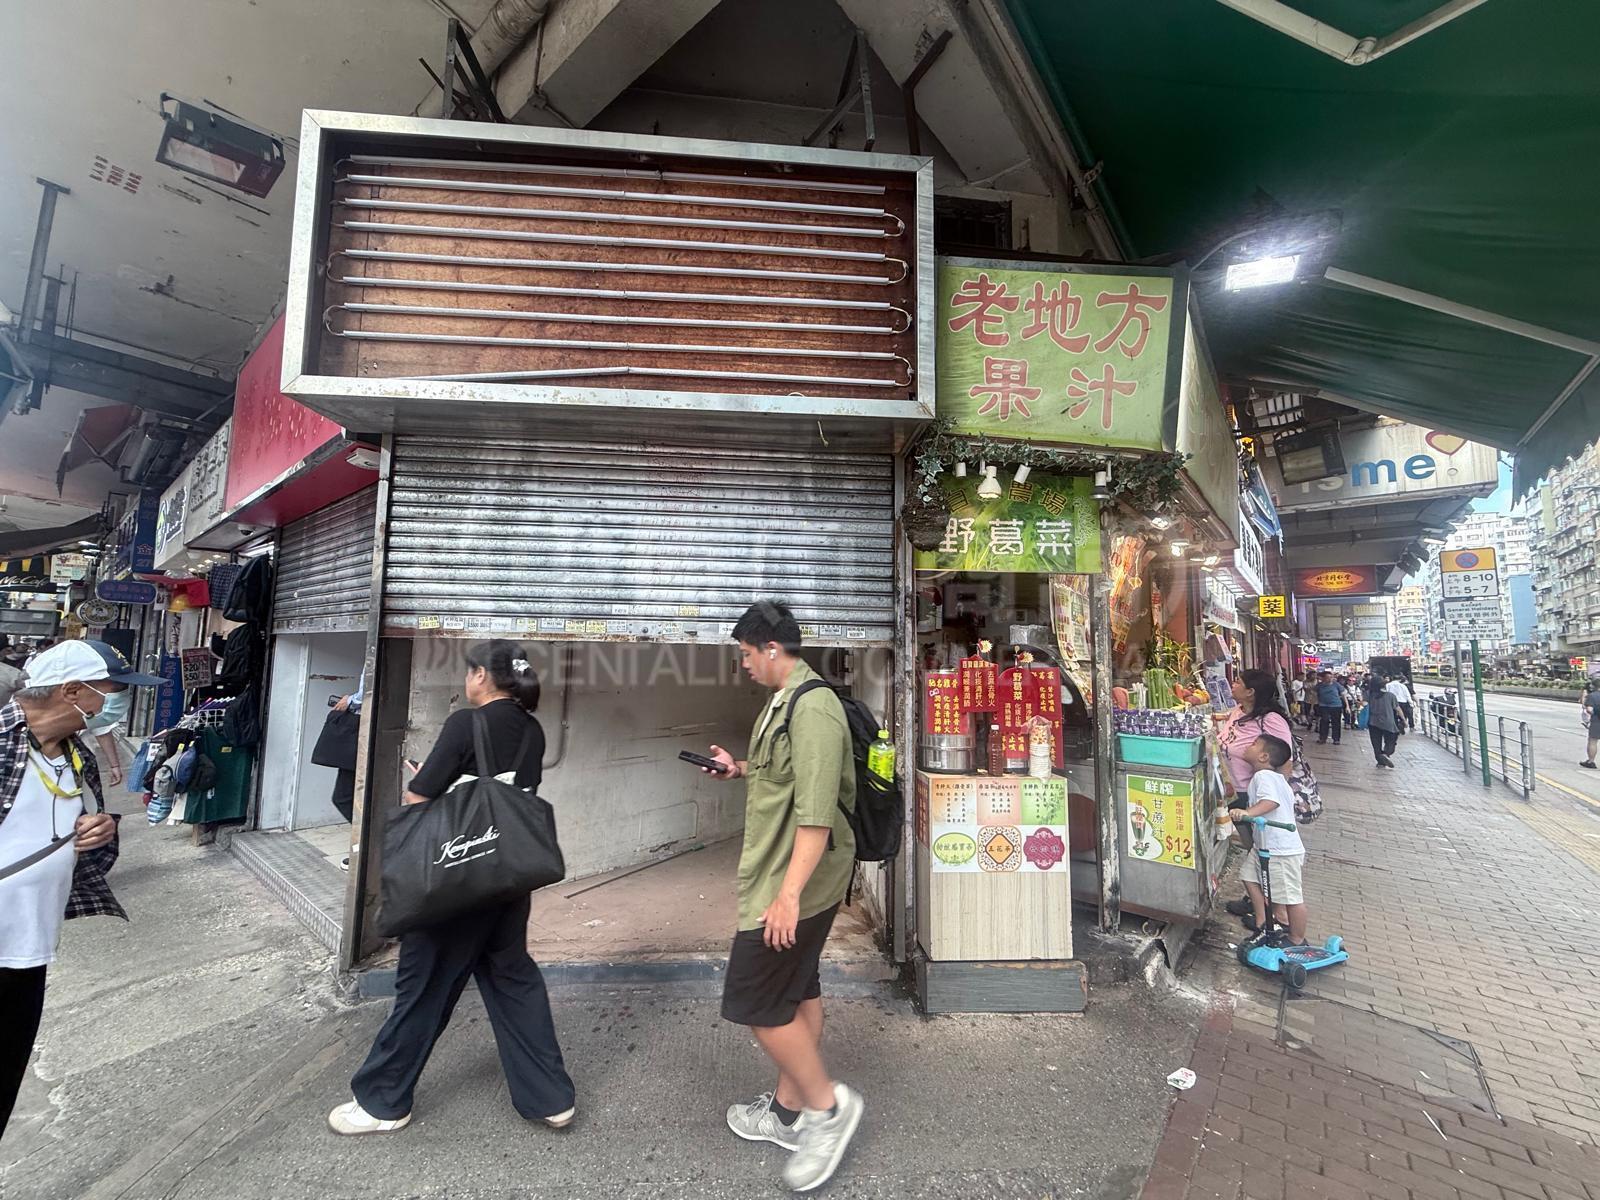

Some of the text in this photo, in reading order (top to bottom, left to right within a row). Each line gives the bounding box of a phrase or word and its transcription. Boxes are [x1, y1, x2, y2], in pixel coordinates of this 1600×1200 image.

[947, 271, 1169, 358] 老地方
[969, 356, 1138, 431] 果汁
[1351, 454, 1437, 488] me
[938, 518, 1073, 556] 野葛菜
[1463, 573, 1494, 582] 8-10
[1012, 672, 1023, 701] 野葛菜
[1144, 780, 1174, 795] 鮮榨
[1151, 798, 1165, 838] 甘蔗汁
